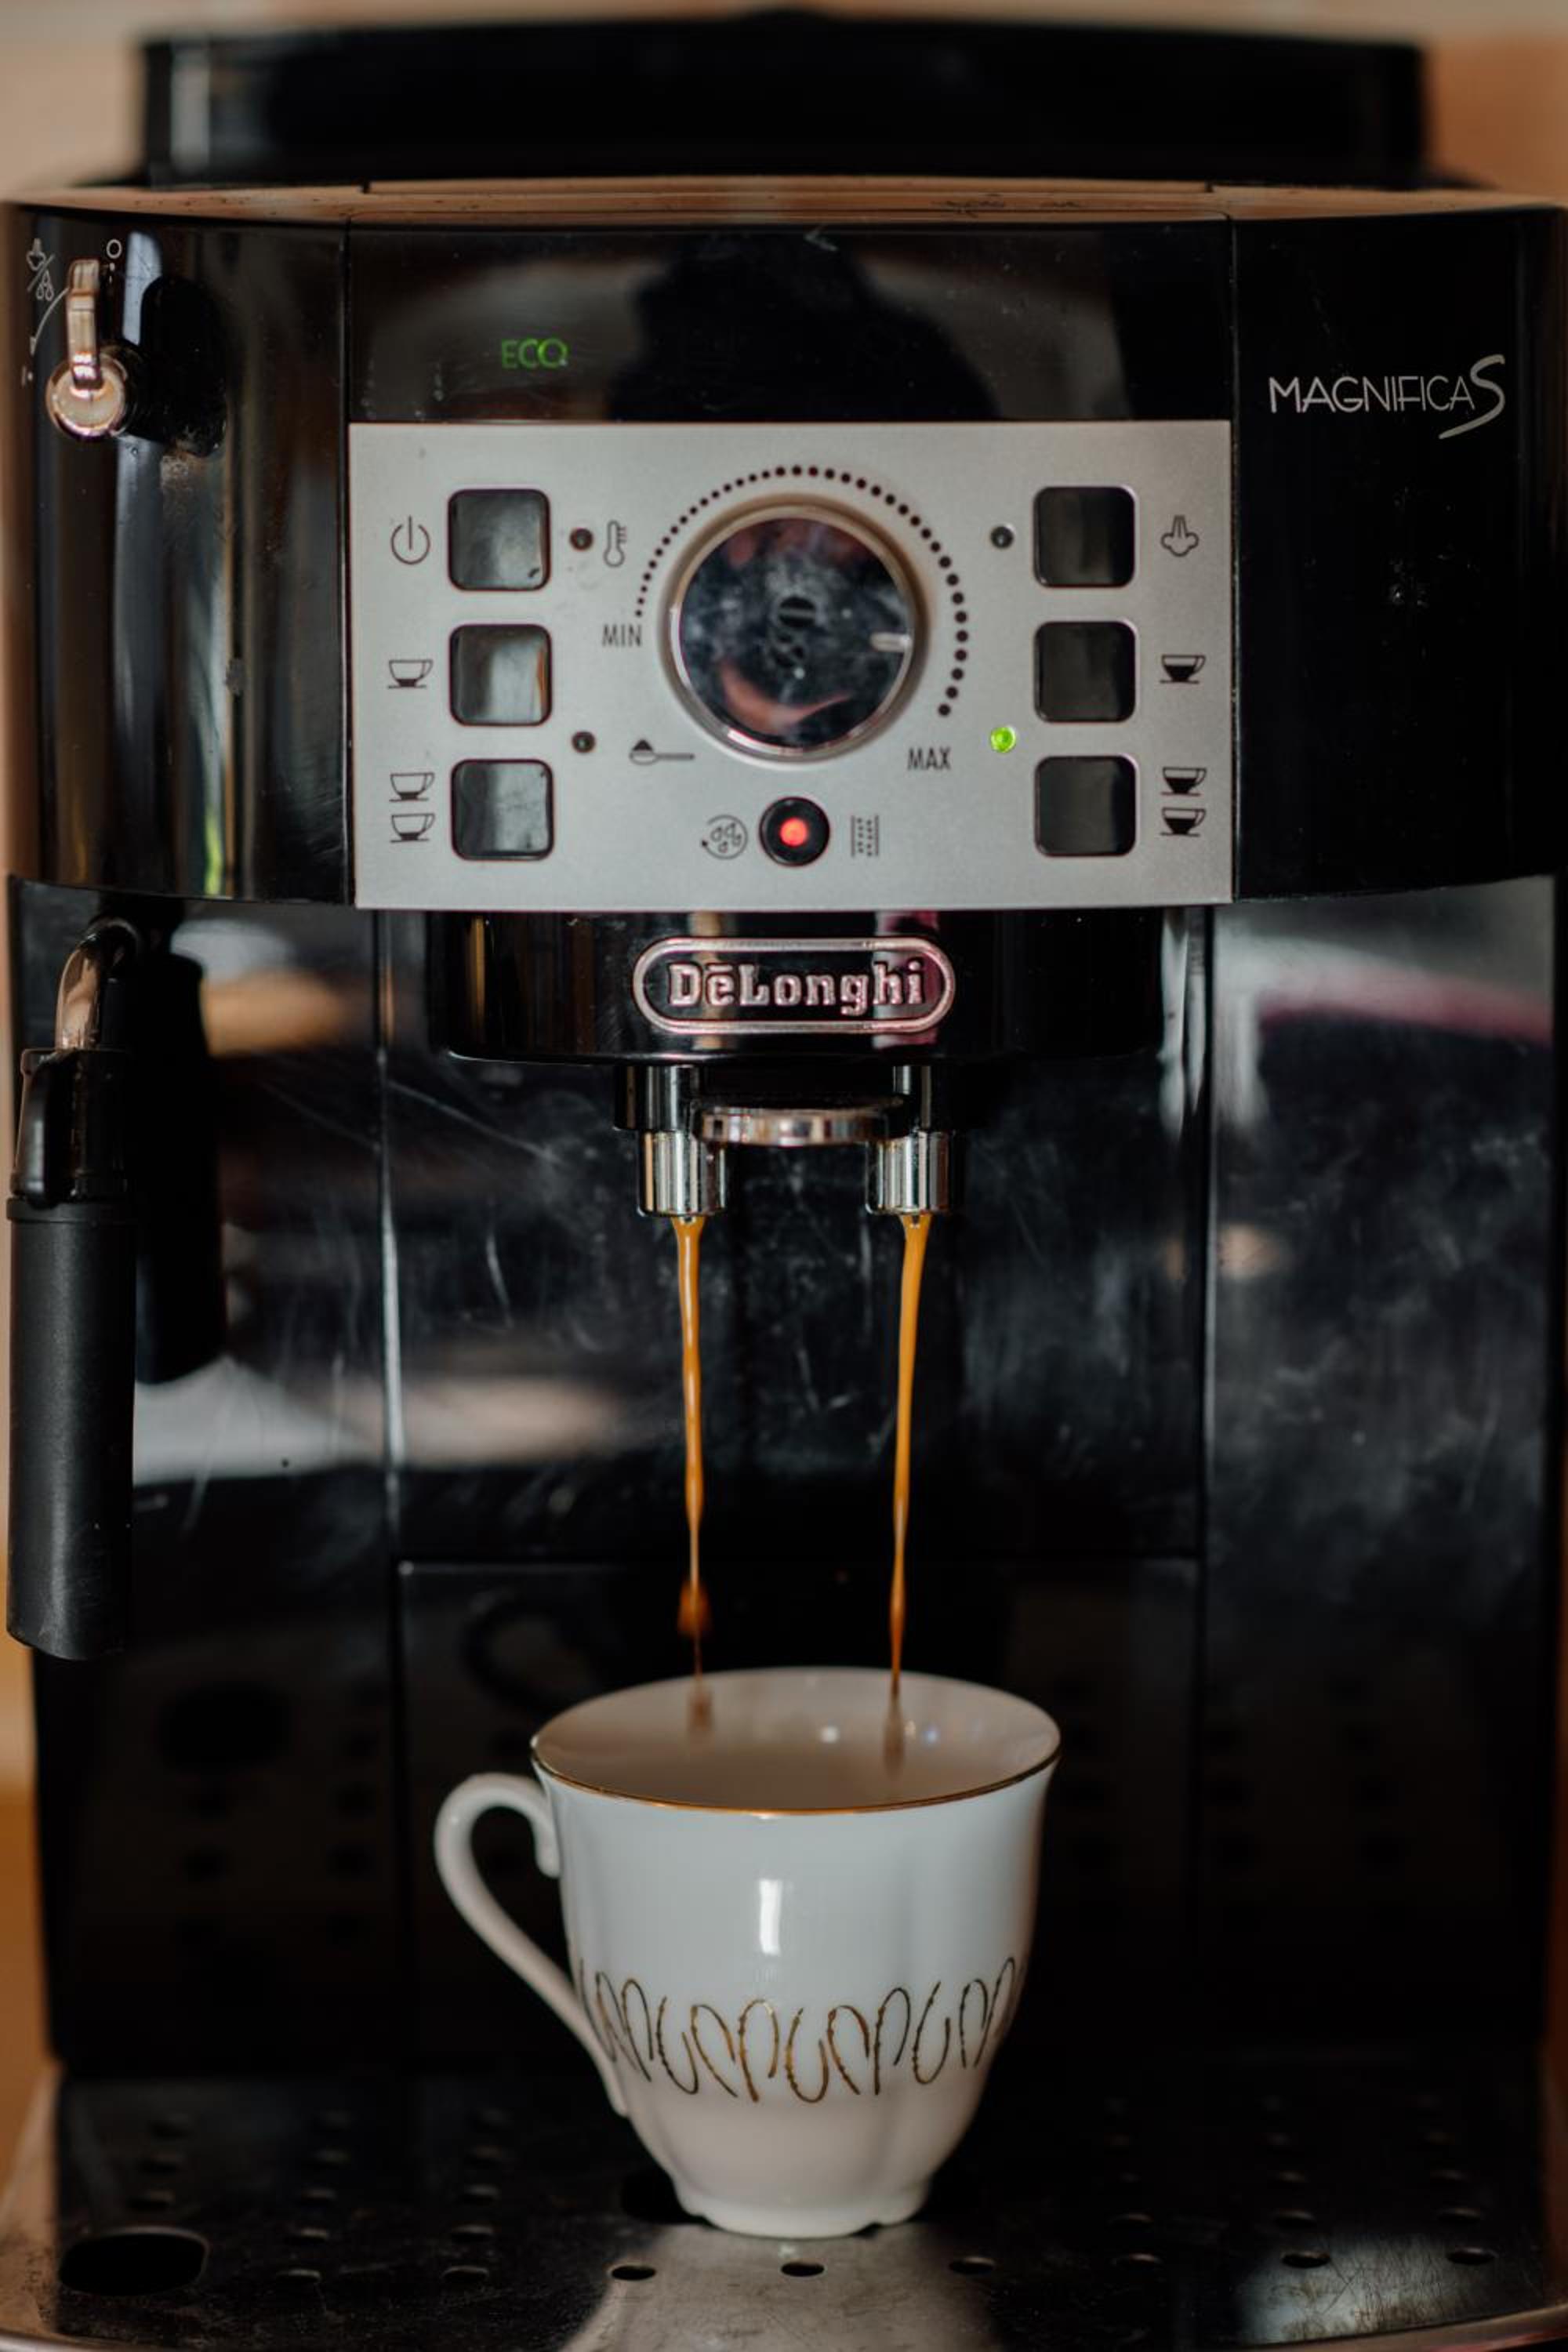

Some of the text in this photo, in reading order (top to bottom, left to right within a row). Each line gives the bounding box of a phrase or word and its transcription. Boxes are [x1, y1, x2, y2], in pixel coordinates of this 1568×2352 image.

[502, 338, 568, 369] ECO
[601, 623, 642, 648] MIN
[907, 746, 952, 771] MAX
